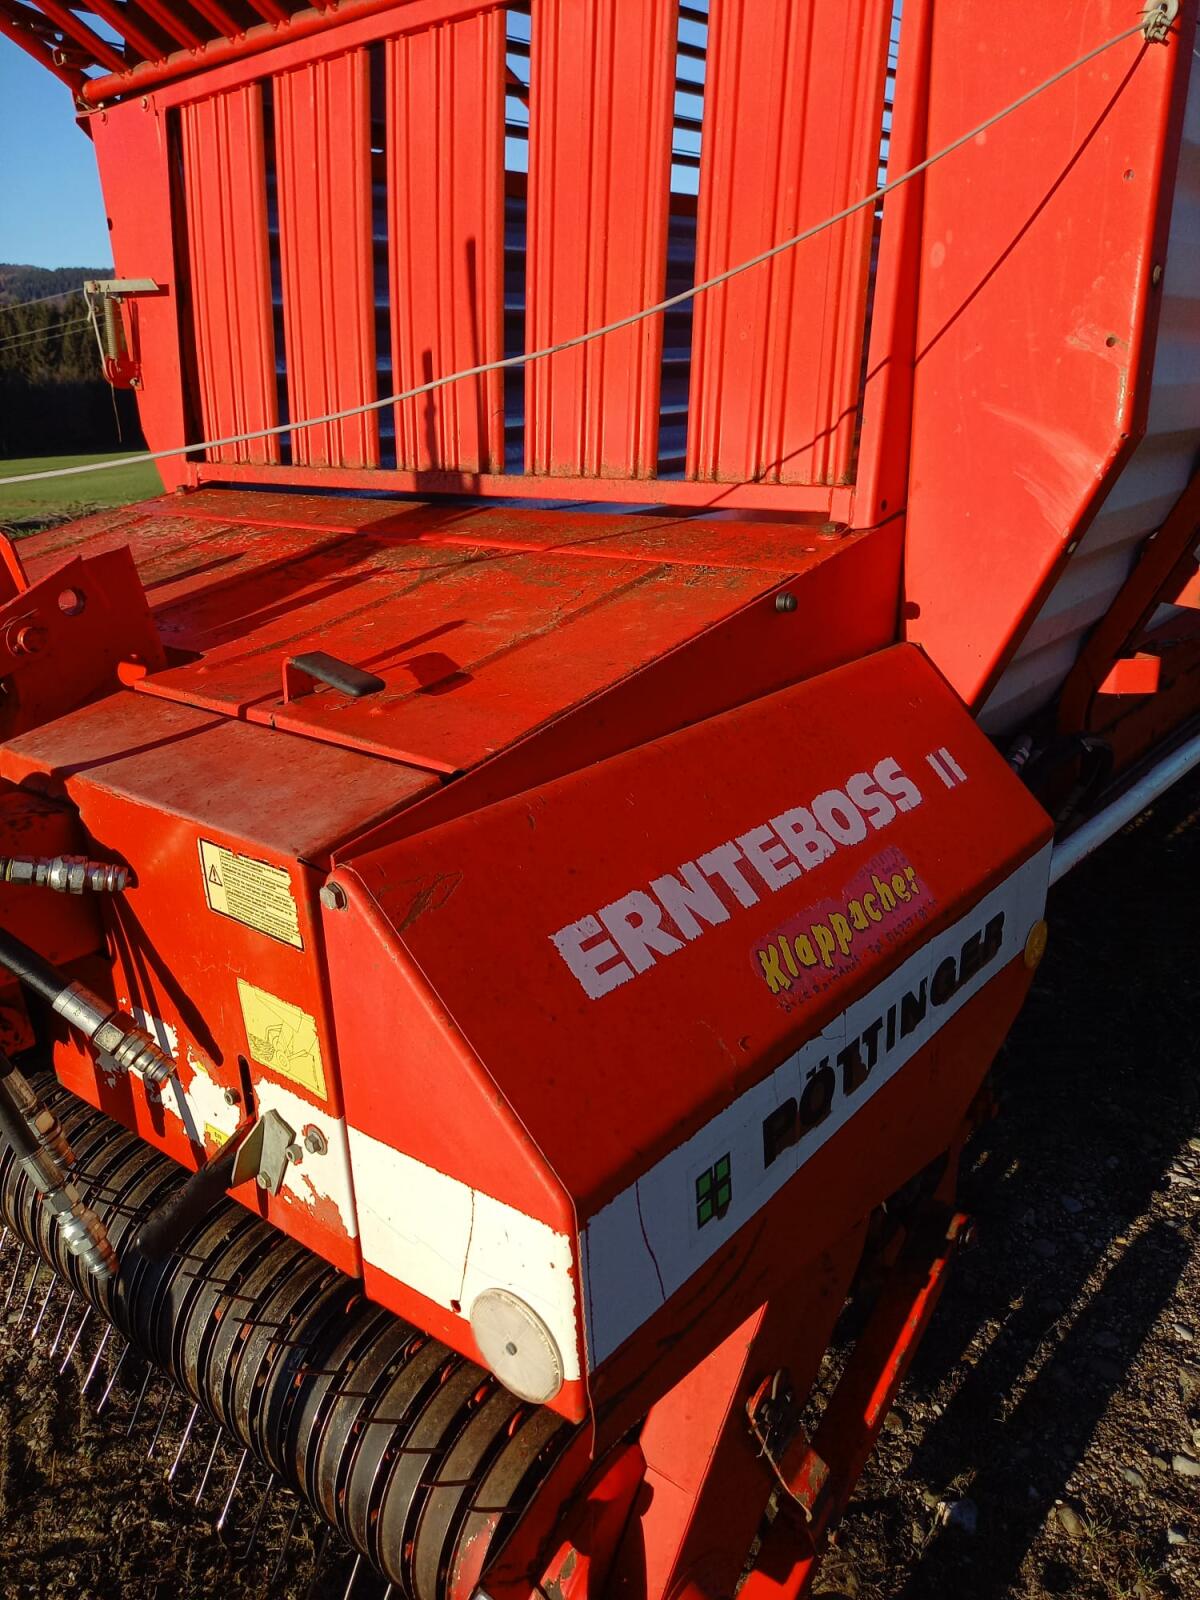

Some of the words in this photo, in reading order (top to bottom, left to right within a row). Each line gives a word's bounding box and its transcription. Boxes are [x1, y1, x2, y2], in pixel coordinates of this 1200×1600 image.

[548, 757, 922, 1000] ERNTEBOSS
[759, 866, 919, 993] Klappacher
[763, 911, 1005, 1169] PÖTTINGER
